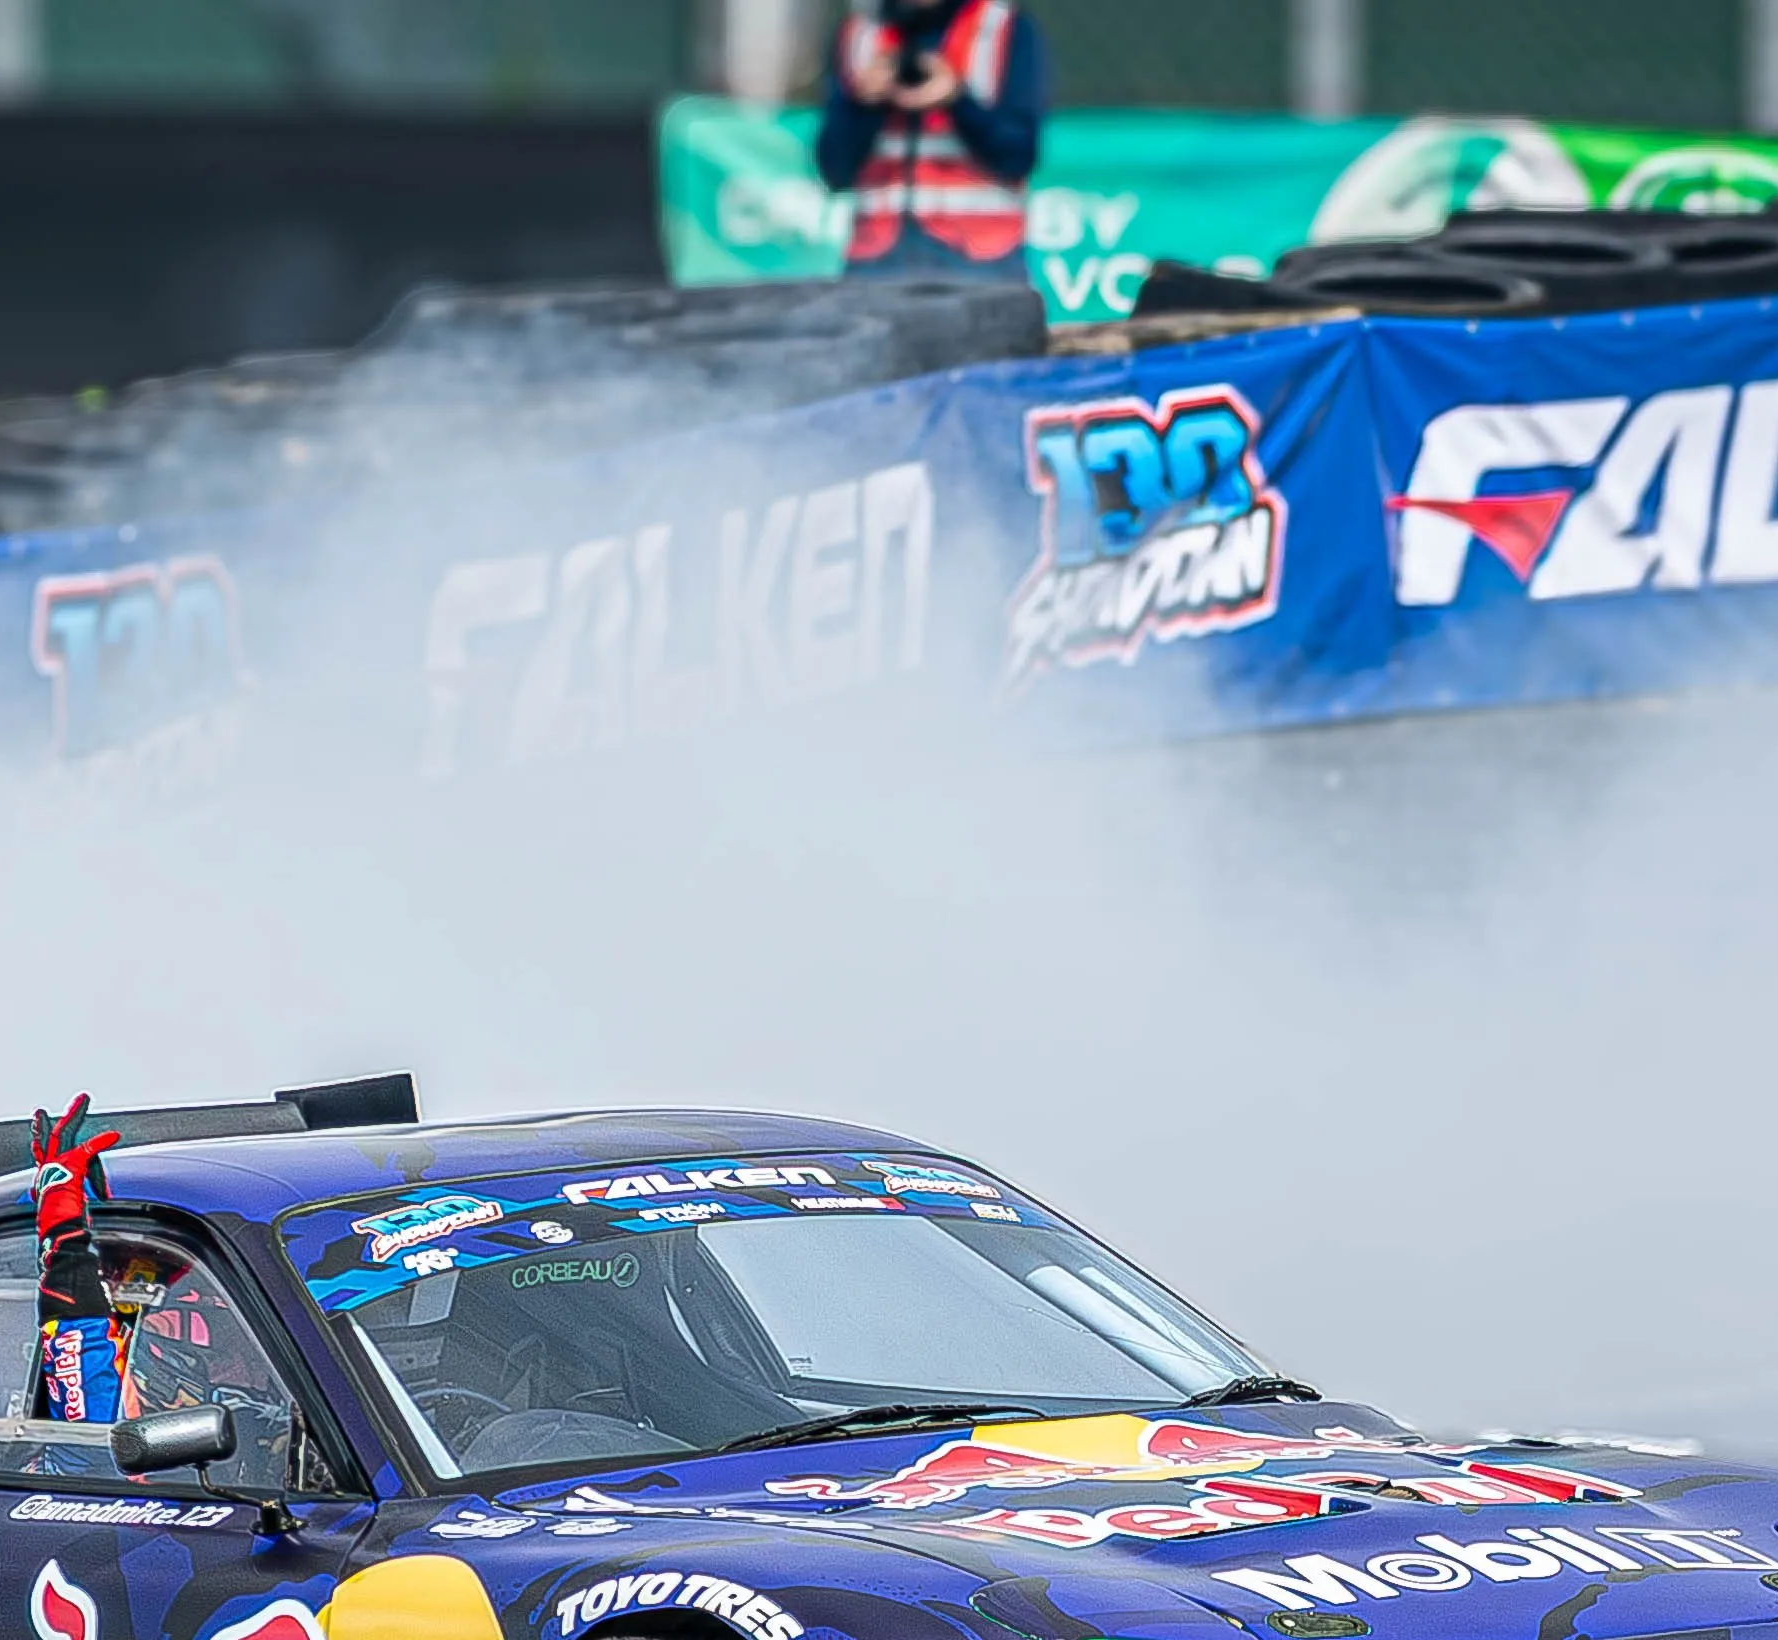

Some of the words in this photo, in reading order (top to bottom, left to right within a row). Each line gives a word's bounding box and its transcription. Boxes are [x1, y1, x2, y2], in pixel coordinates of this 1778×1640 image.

[418, 462, 932, 780] FALKEN
[559, 1166, 836, 1206] FALKEN
[512, 1260, 613, 1289] CORBEAU
[1211, 1528, 1644, 1611] Mobil
[557, 1572, 683, 1637] TOYO
